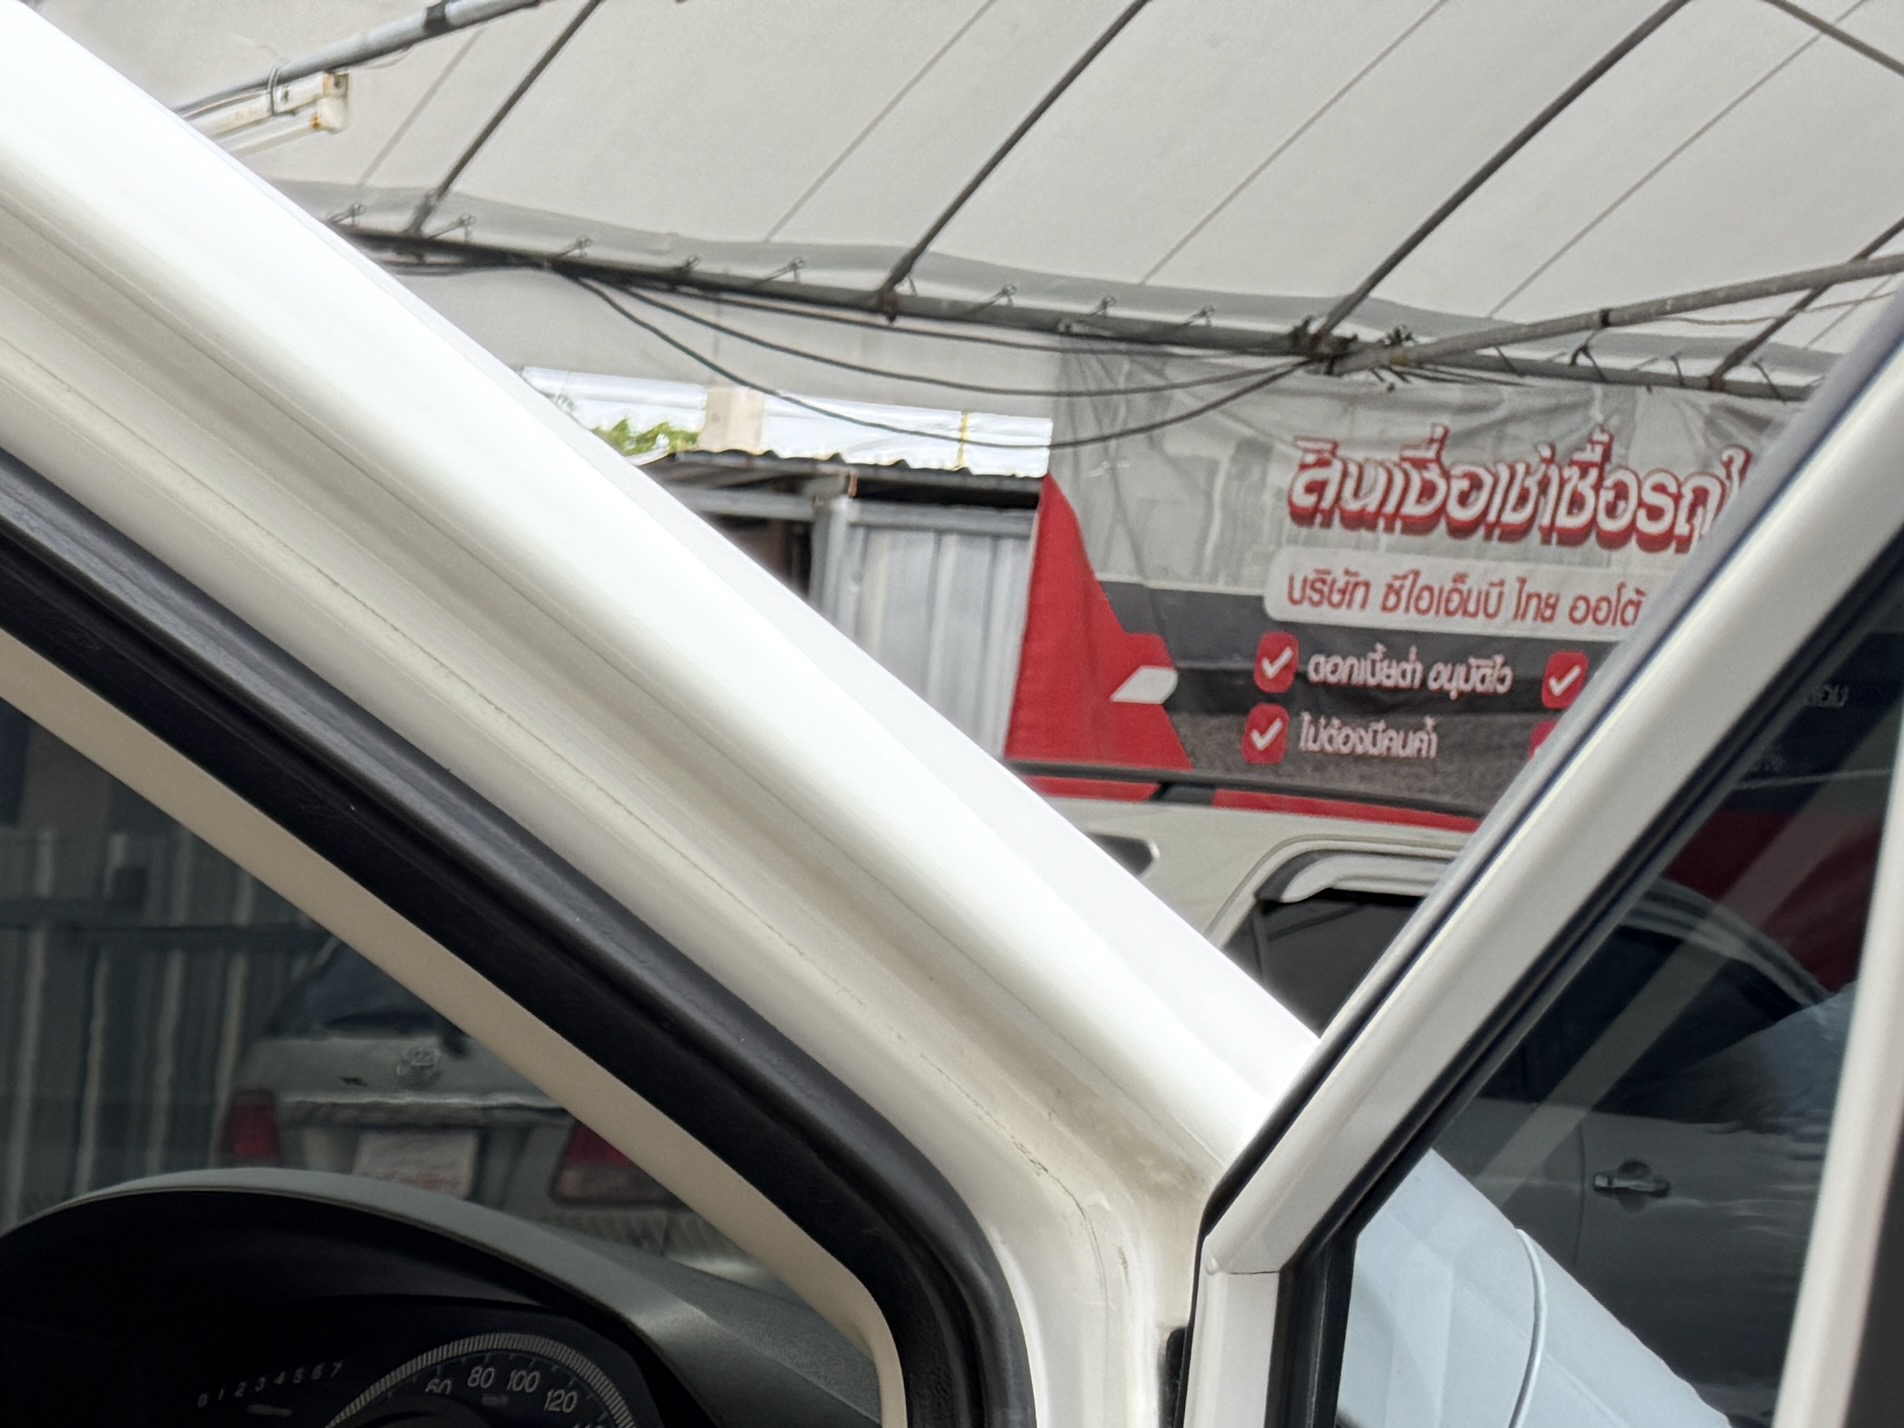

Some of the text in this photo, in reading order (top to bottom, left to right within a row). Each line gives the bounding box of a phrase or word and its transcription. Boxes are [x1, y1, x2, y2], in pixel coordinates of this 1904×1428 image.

[1287, 566, 1370, 612] บริษัท
[1511, 576, 1558, 624] ไทย
[466, 1366, 495, 1389] 80
[506, 1370, 540, 1394] 100
[544, 1389, 578, 1414] 120
